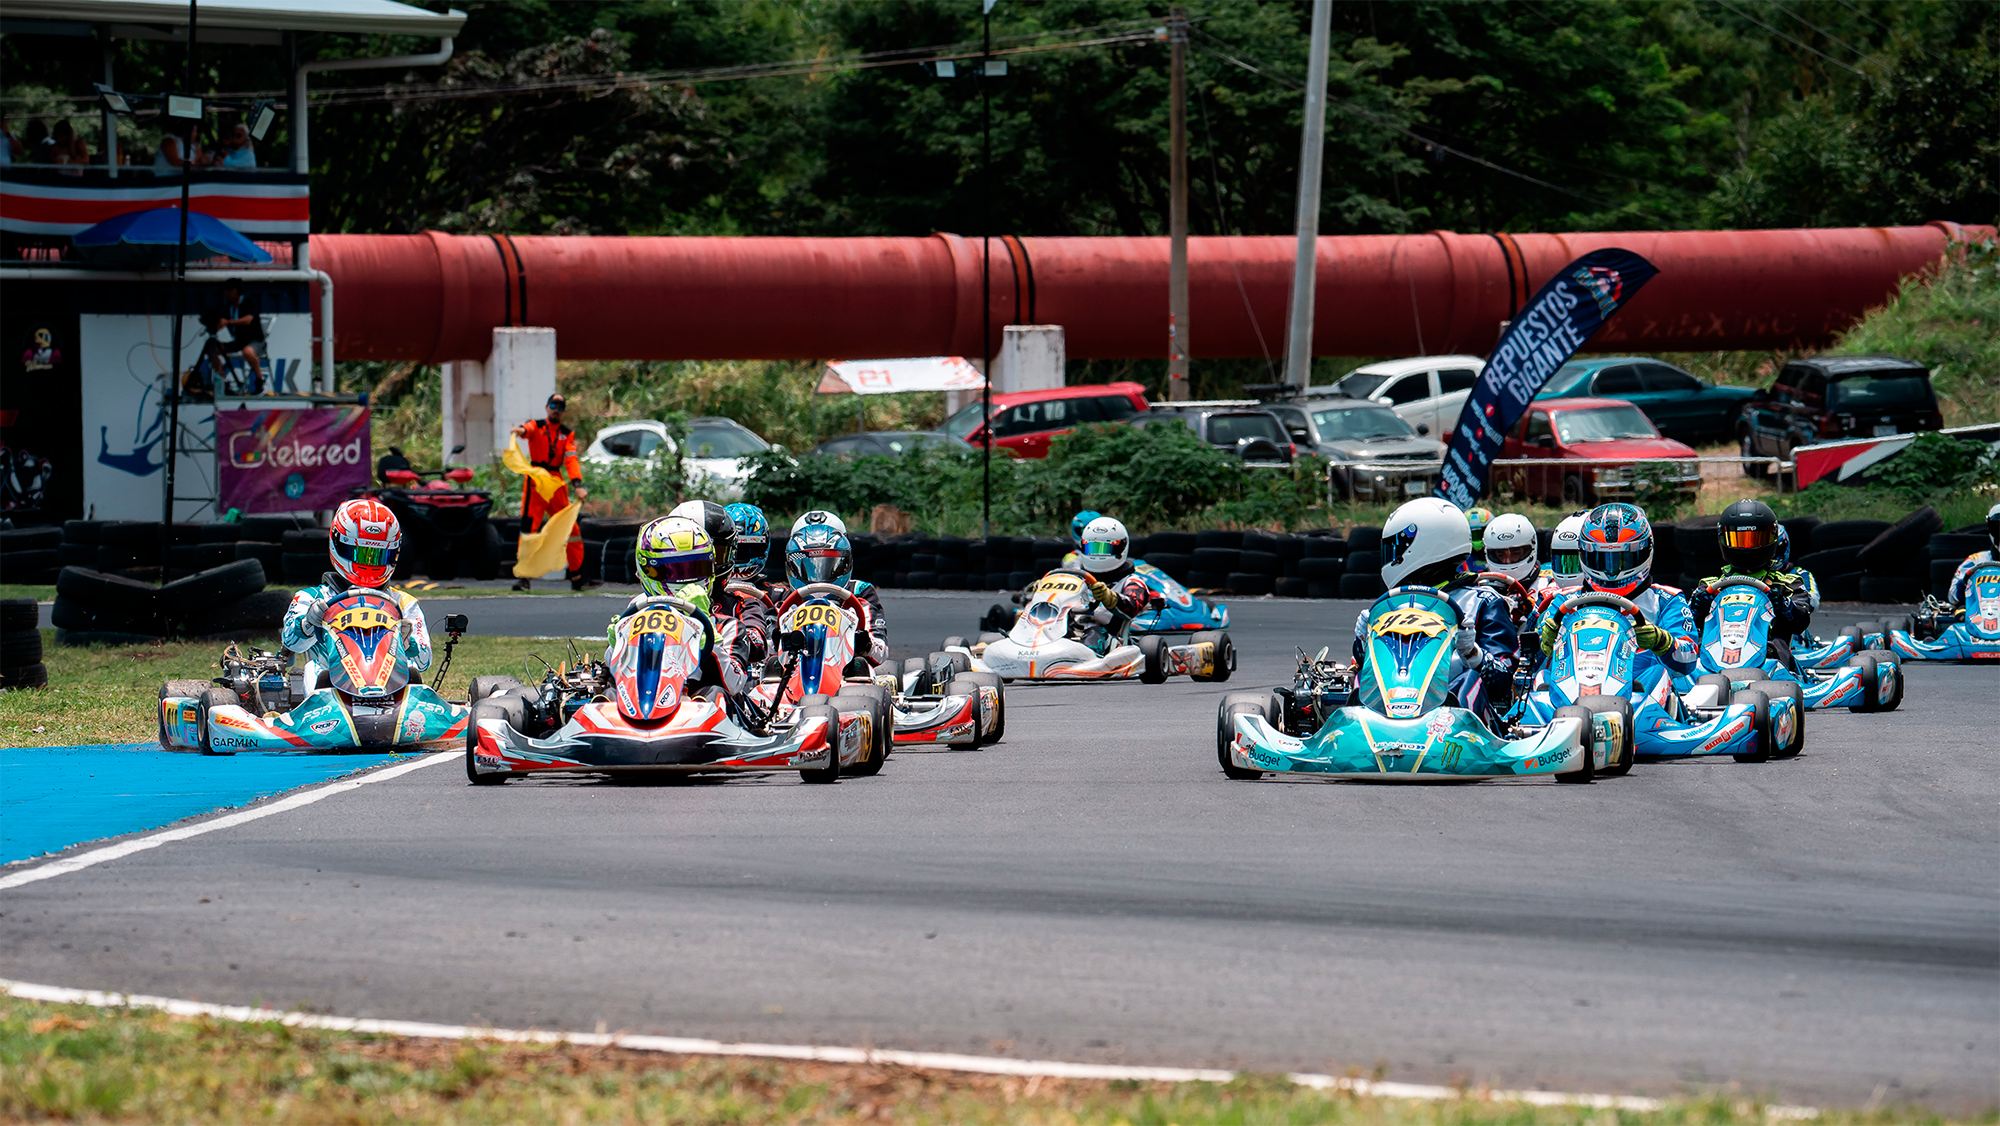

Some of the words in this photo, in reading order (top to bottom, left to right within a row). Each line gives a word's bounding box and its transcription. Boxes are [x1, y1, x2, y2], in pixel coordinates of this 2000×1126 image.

[1484, 281, 1578, 396] REPUESTOS
[1507, 317, 1586, 405] GIGANTE
[859, 369, 892, 386] P1
[267, 437, 362, 467] telered
[632, 612, 678, 635] 969
[796, 606, 837, 627] 906
[1379, 614, 1442, 631] 957
[344, 660, 361, 681] DHL
[379, 658, 393, 681] DHL
[660, 688, 671, 705] ROK
[220, 716, 251, 729] DHL
[315, 721, 336, 730] ROK
[213, 737, 258, 748] GARMIN
[1249, 748, 1280, 766] Budget
[1538, 748, 1572, 767] Budget
